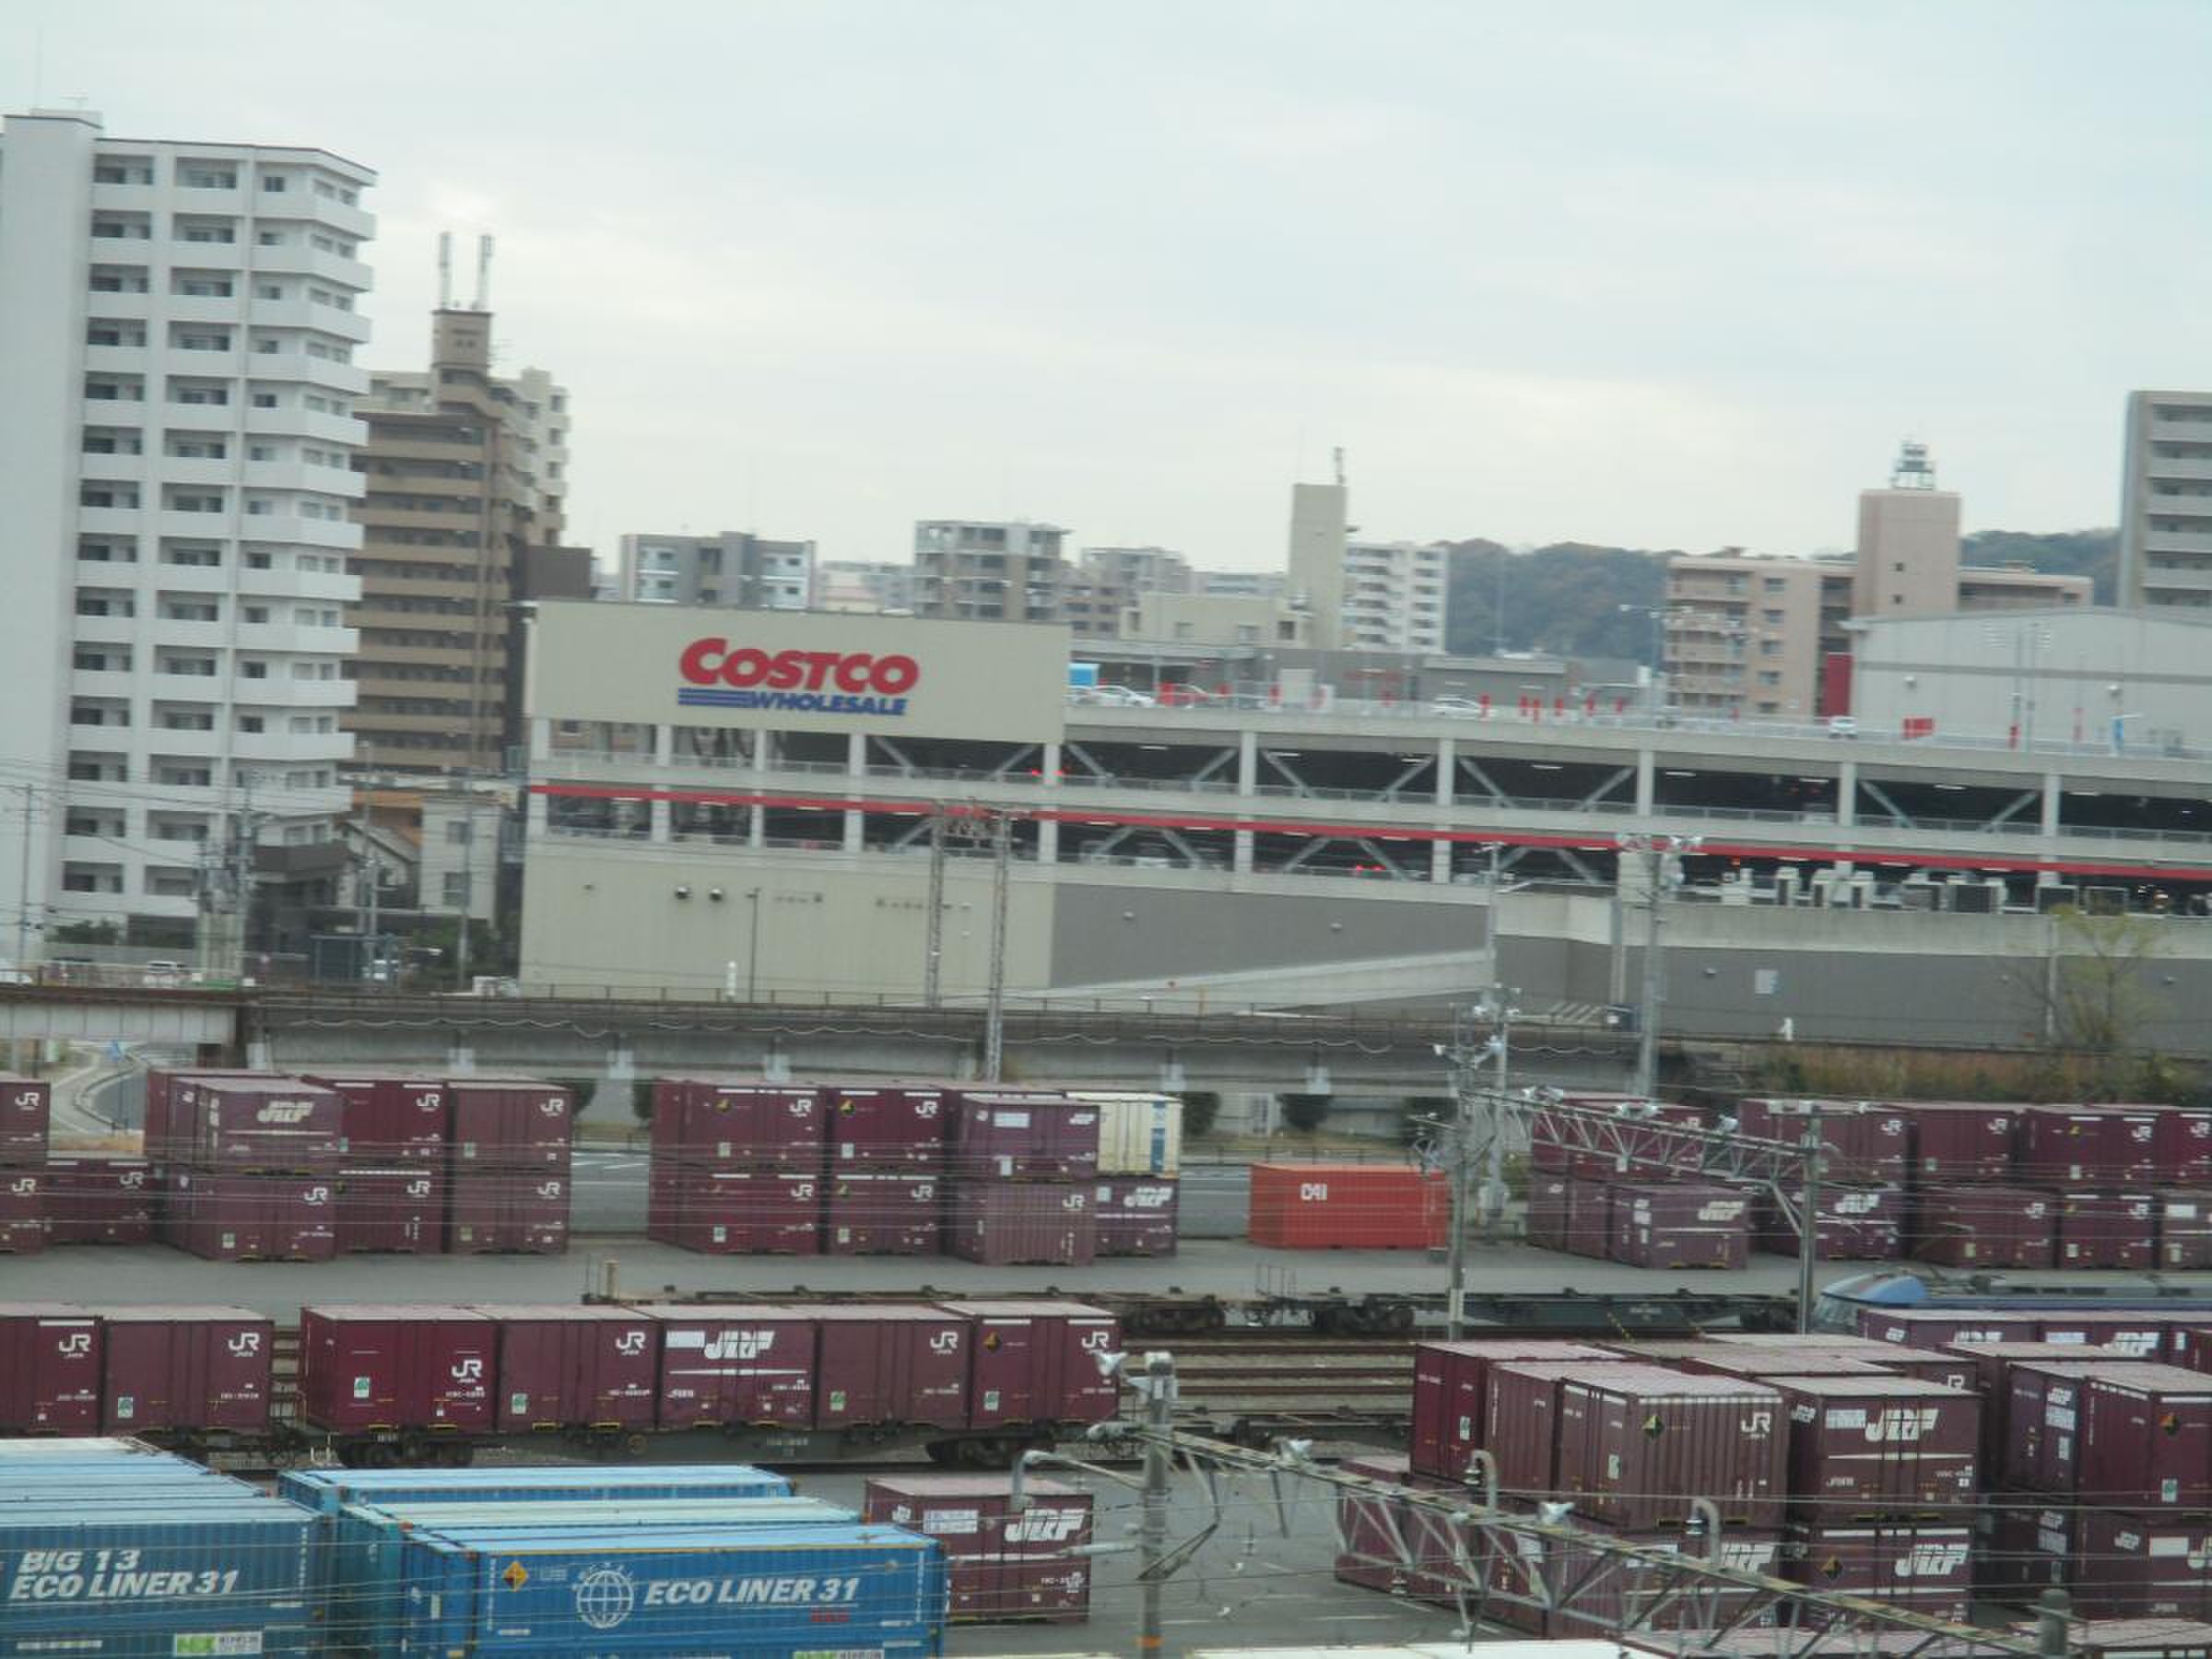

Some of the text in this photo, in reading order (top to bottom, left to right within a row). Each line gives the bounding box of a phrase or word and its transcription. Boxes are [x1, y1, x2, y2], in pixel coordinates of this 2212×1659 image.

[680, 637, 918, 693] COSTCO
[751, 691, 908, 716] WHOLESALE
[59, 1335, 90, 1352] JR
[229, 1334, 260, 1351] JR
[616, 1332, 645, 1348] JR
[930, 1332, 959, 1348] JR
[1082, 1332, 1110, 1348] JR
[453, 1359, 482, 1378] JR
[1741, 1413, 1771, 1432] JR
[18, 1548, 142, 1573] BIG 13
[9, 1570, 240, 1600] ECO LINER 31
[644, 1577, 860, 1605] ECO LINER 31
